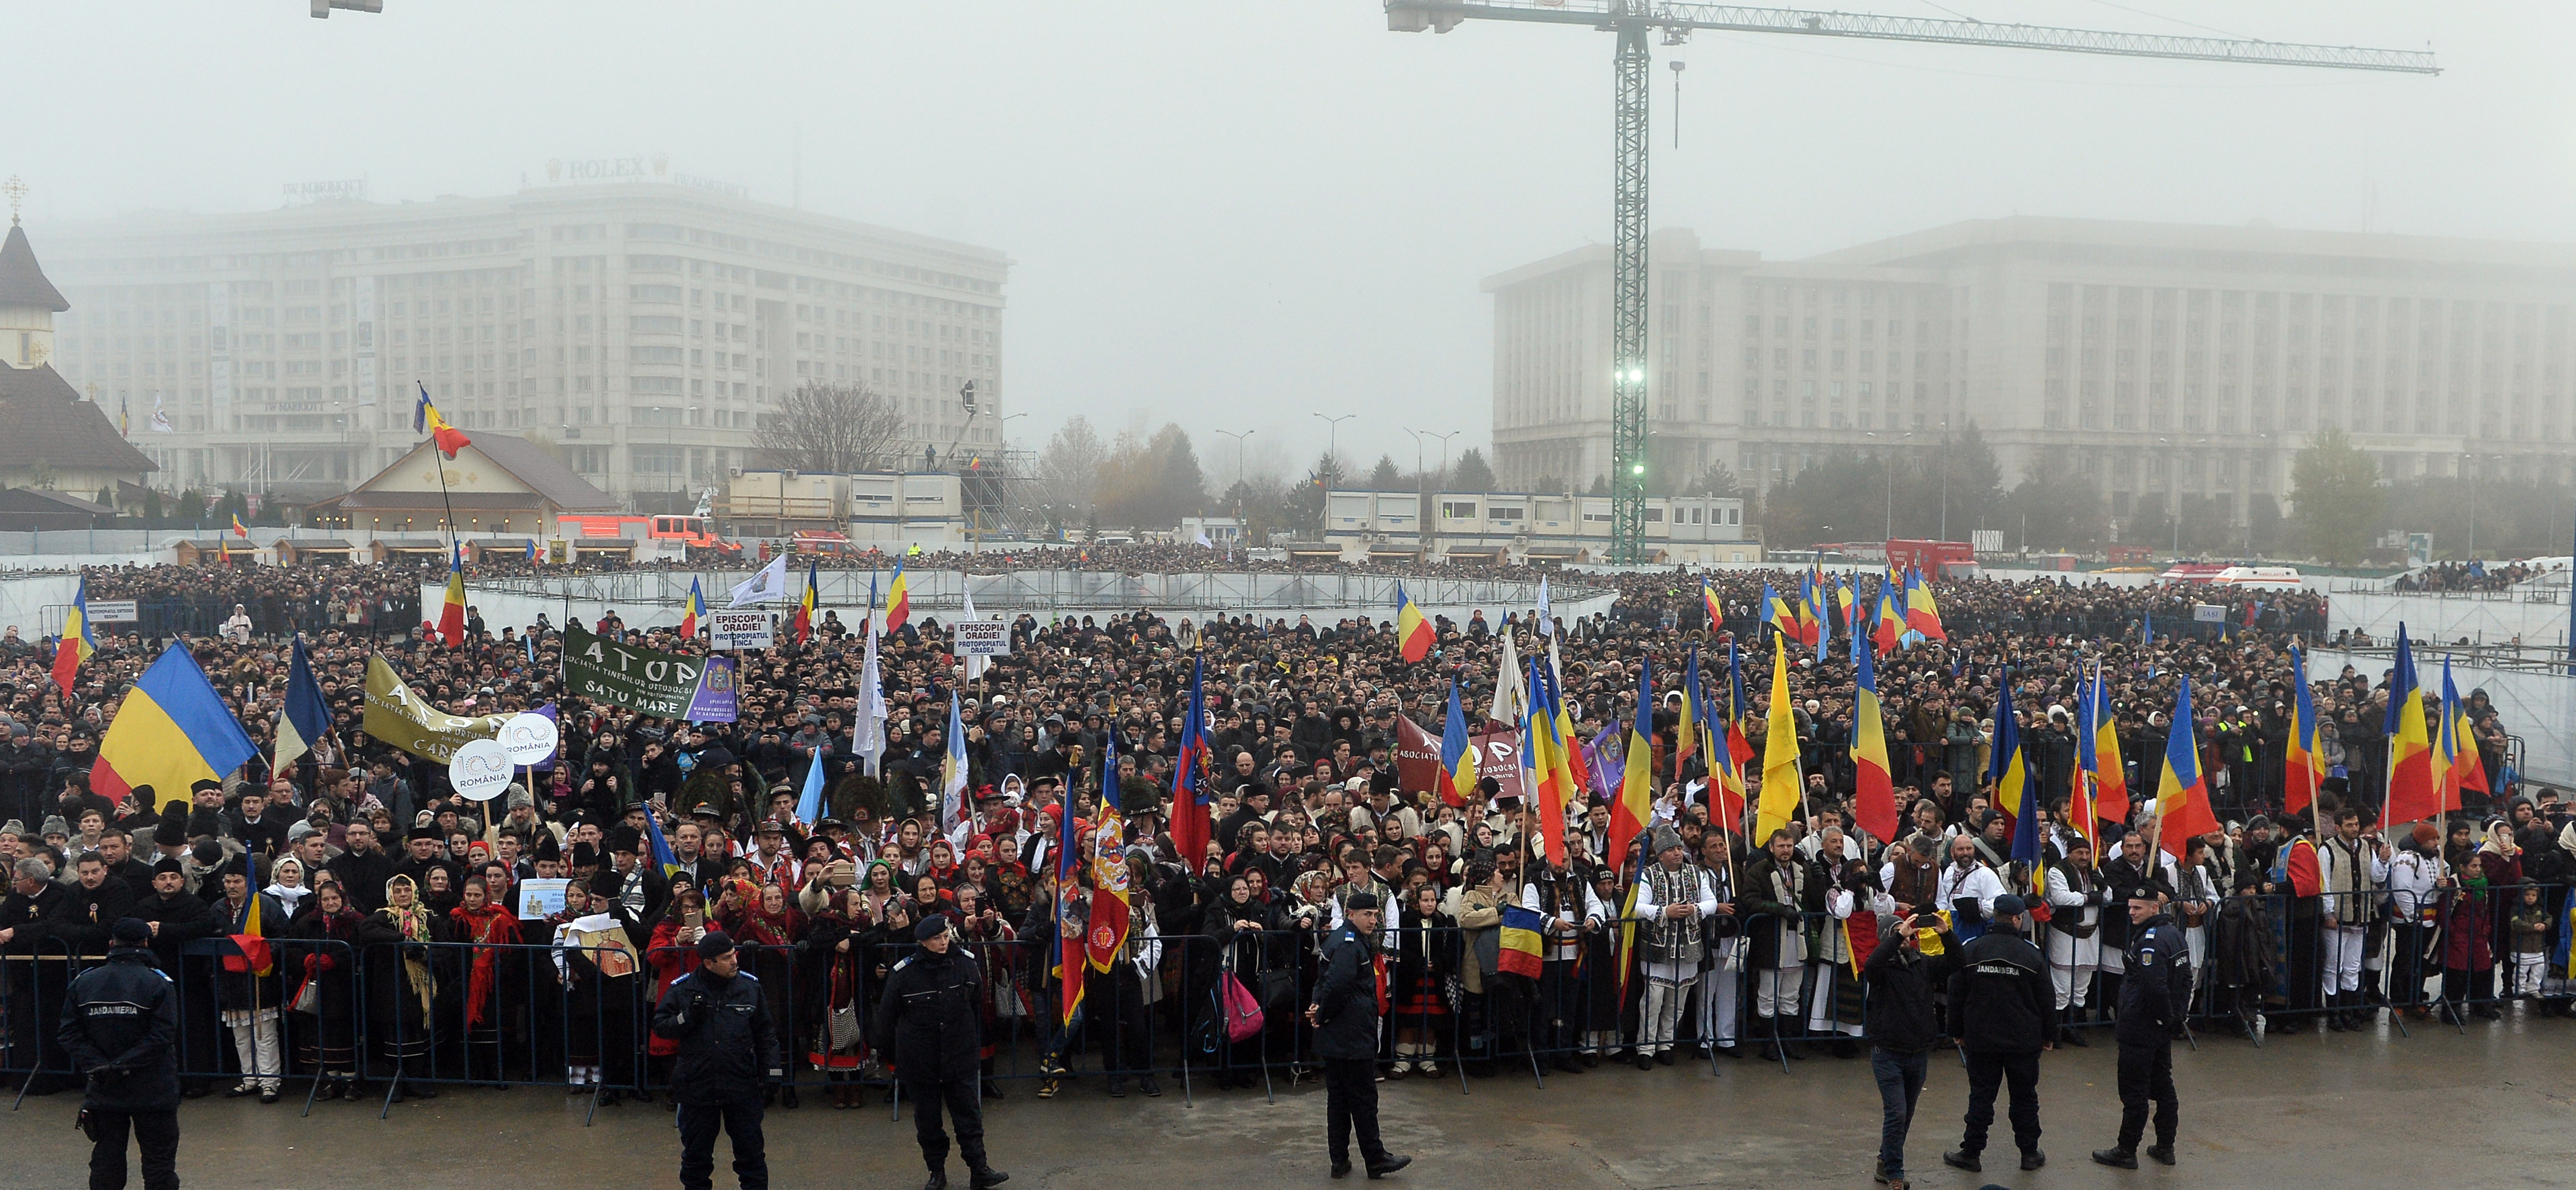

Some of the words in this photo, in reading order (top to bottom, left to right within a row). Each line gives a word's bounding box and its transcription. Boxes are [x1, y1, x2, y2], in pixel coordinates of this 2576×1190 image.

[569, 157, 646, 179] ROLEX
[301, 180, 365, 193] MARRIOTT
[265, 402, 276, 411] JW
[279, 402, 323, 411] MARRIOTT
[716, 615, 766, 624] EPISCOPIA
[722, 623, 761, 631] ORADIEI
[585, 642, 697, 685] ATOP
[564, 655, 600, 673] SOCIAȚIA
[603, 668, 645, 688] TINERILOR
[585, 680, 629, 702] SATU
[635, 696, 679, 714] MARE
[460, 773, 507, 788] ROMÂNIA
[1976, 965, 2019, 976] JANDARMERIA
